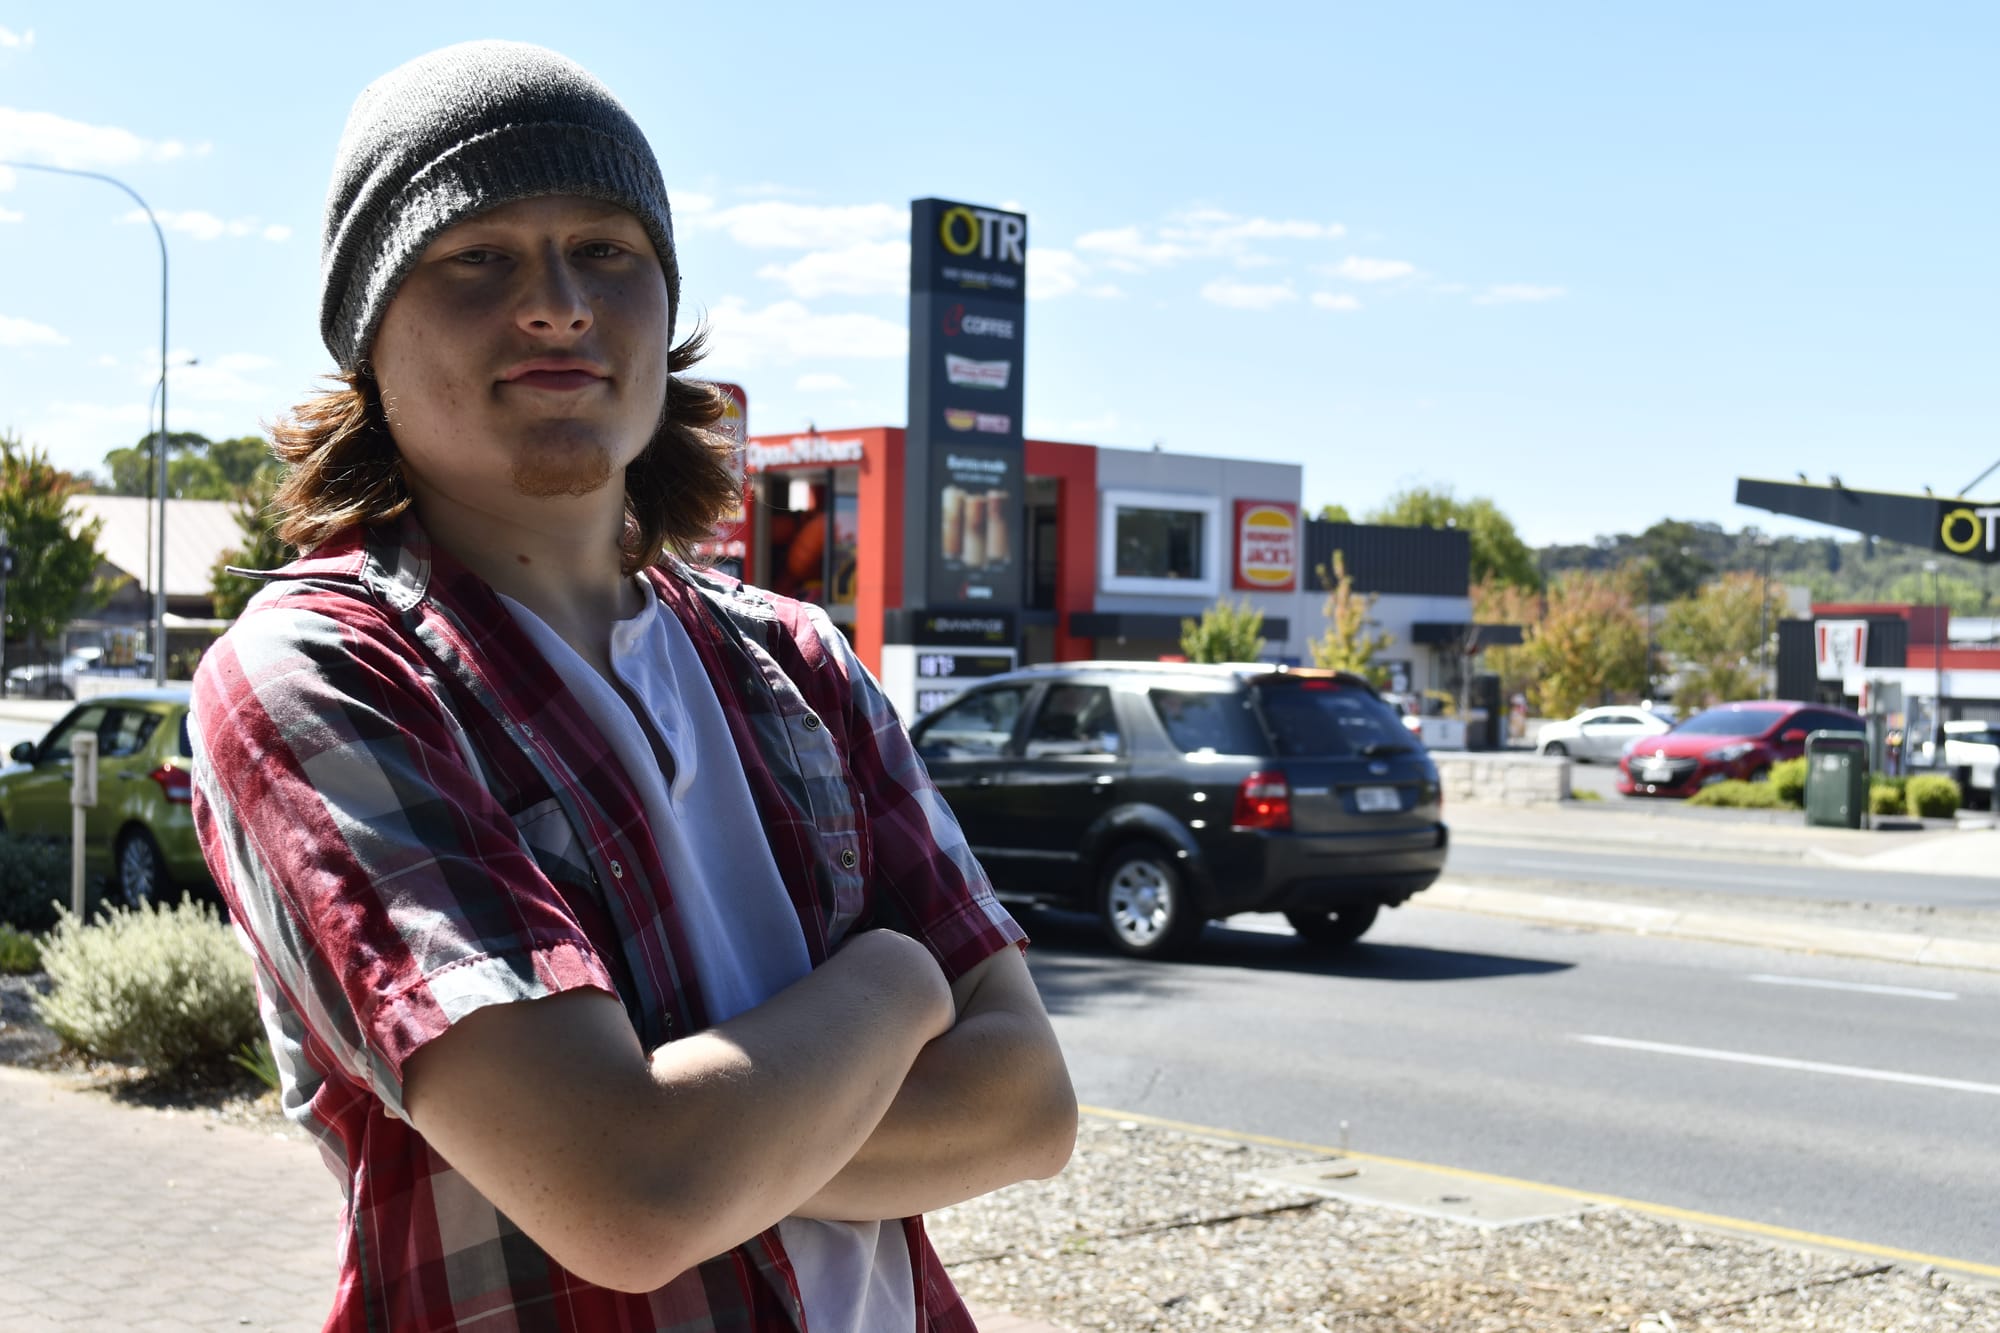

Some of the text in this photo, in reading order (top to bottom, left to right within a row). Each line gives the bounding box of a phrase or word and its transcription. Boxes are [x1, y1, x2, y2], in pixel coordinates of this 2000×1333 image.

[940, 206, 1025, 263] OTR
[961, 314, 1016, 339] COFFEE
[746, 441, 789, 472] Open
[813, 436, 864, 462] Hours
